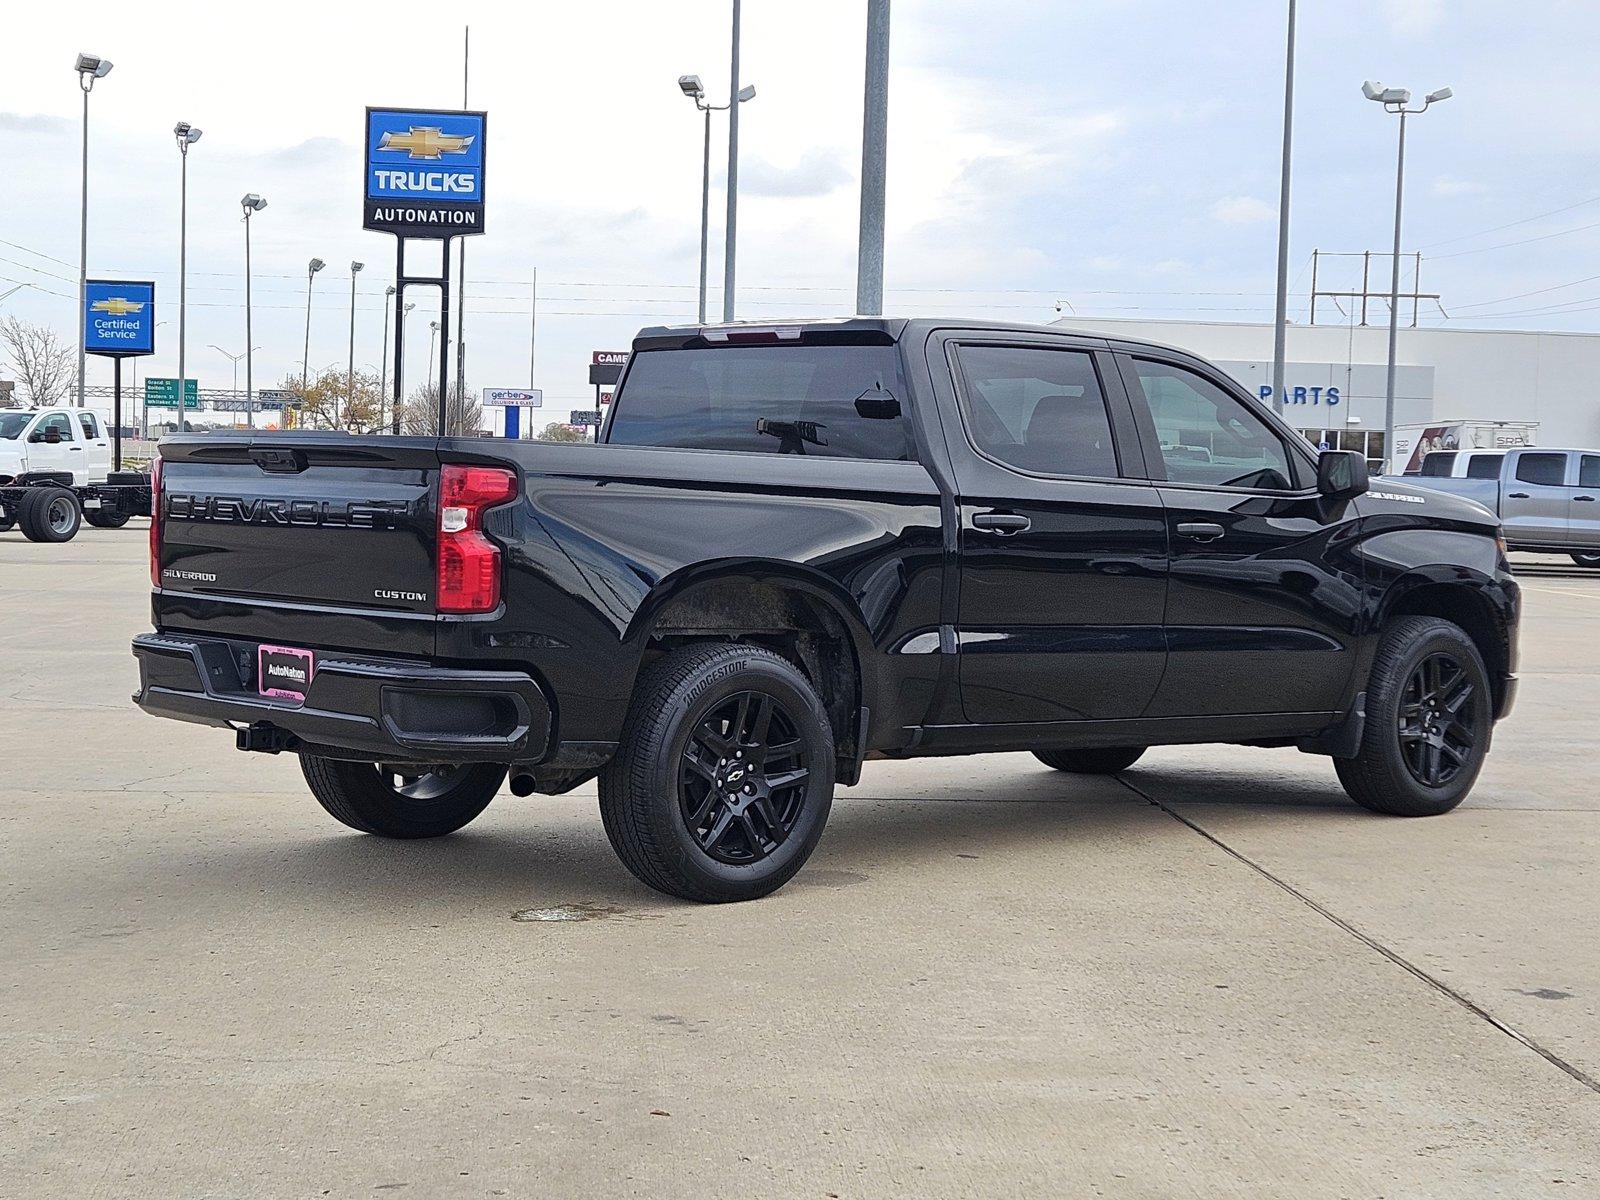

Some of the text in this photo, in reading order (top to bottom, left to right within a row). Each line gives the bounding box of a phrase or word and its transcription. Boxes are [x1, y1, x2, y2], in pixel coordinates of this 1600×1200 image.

[374, 170, 475, 192] TRUCKS
[374, 208, 476, 224] AUTONATION
[94, 319, 140, 330] Certified
[97, 329, 137, 339] Service
[491, 390, 524, 400] gerber
[1496, 436, 1524, 445] SRP
[168, 494, 408, 530] CHEVROLET
[163, 569, 217, 582] SILVERADO
[374, 589, 427, 602] CUSTOM
[268, 664, 306, 680] AutoNation
[683, 660, 748, 707] BRIDGESTONE
